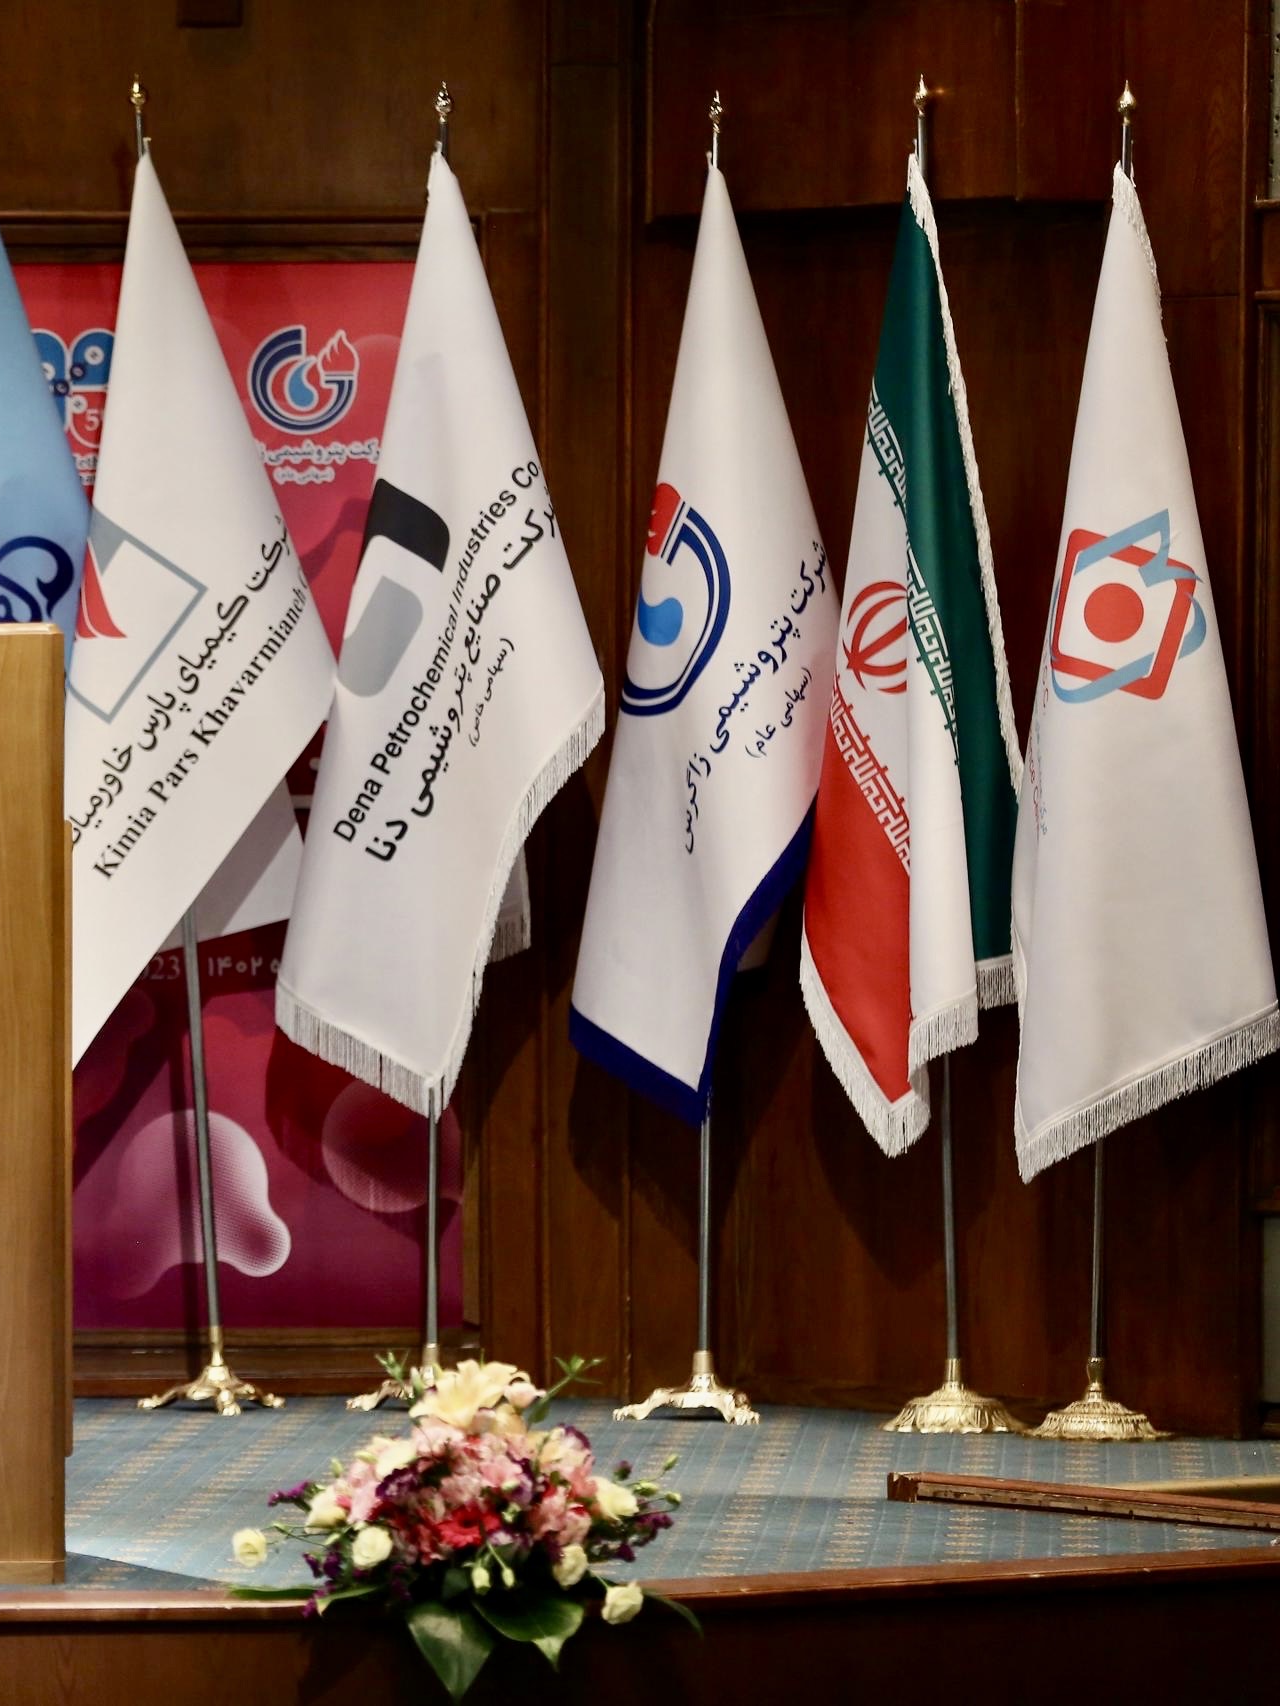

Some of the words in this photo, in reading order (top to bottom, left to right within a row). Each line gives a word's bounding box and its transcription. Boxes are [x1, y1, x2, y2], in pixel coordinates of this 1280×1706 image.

[463, 572, 501, 664] صنایع
[791, 540, 827, 615] شرکت
[178, 594, 249, 695] کیمیای
[333, 778, 383, 842] Dena
[370, 606, 459, 775] Petrochemical
[452, 488, 517, 606] Industries
[710, 615, 801, 754] پتروشیمی
[93, 803, 158, 879] Kimia
[148, 748, 200, 803] Pars
[189, 587, 308, 747] Khavarmianeh
[138, 690, 188, 752] پارس
[411, 661, 473, 818] پتروشیمی
[745, 723, 776, 758] عام)
[365, 817, 409, 862] دنا
[685, 753, 712, 854] زاگرس
[208, 956, 263, 977] ۱۴۰۲
